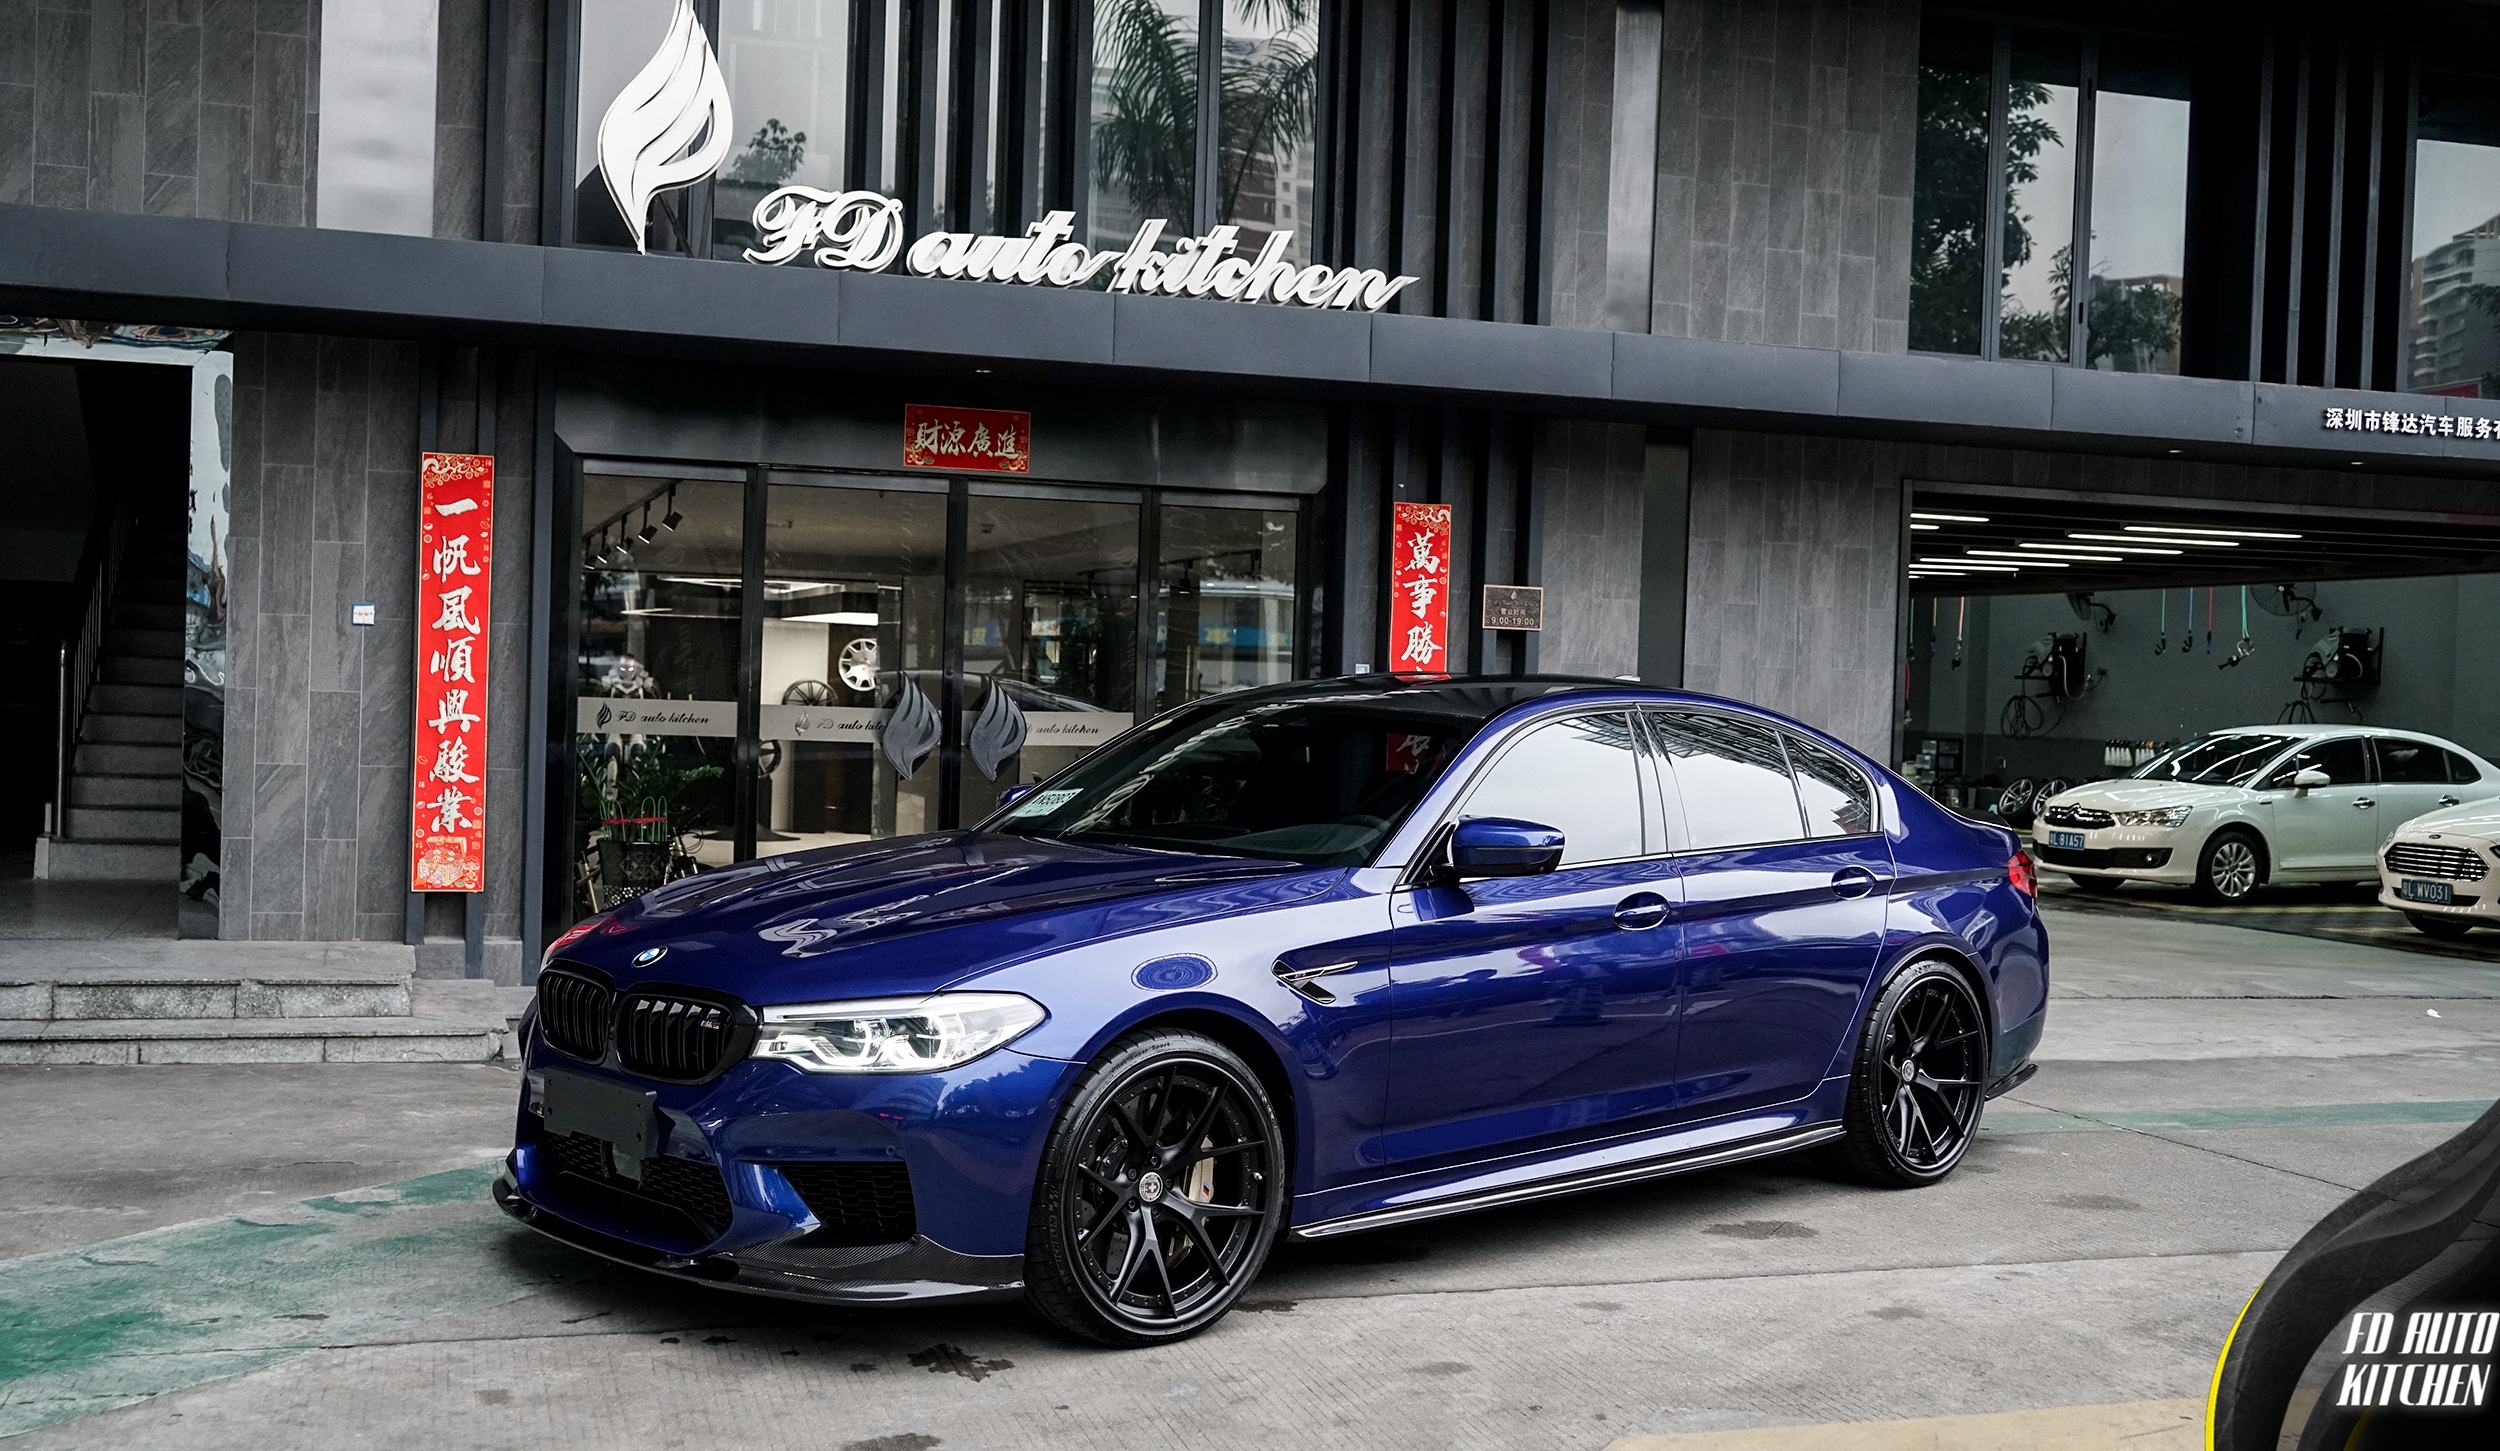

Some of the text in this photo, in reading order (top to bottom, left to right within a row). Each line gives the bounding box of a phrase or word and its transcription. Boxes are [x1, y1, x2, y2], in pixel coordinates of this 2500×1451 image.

[742, 186, 1421, 313] FD auto kitchen
[914, 419, 1019, 459] 財源廣進
[1400, 528, 1443, 672] 萬事勝
[1491, 616, 1535, 626] 9:00-19:00
[640, 712, 667, 723] auto
[668, 712, 709, 724] kitchen
[838, 719, 863, 730] auto
[1036, 723, 1060, 734] auto
[1062, 723, 1099, 734] kitchen
